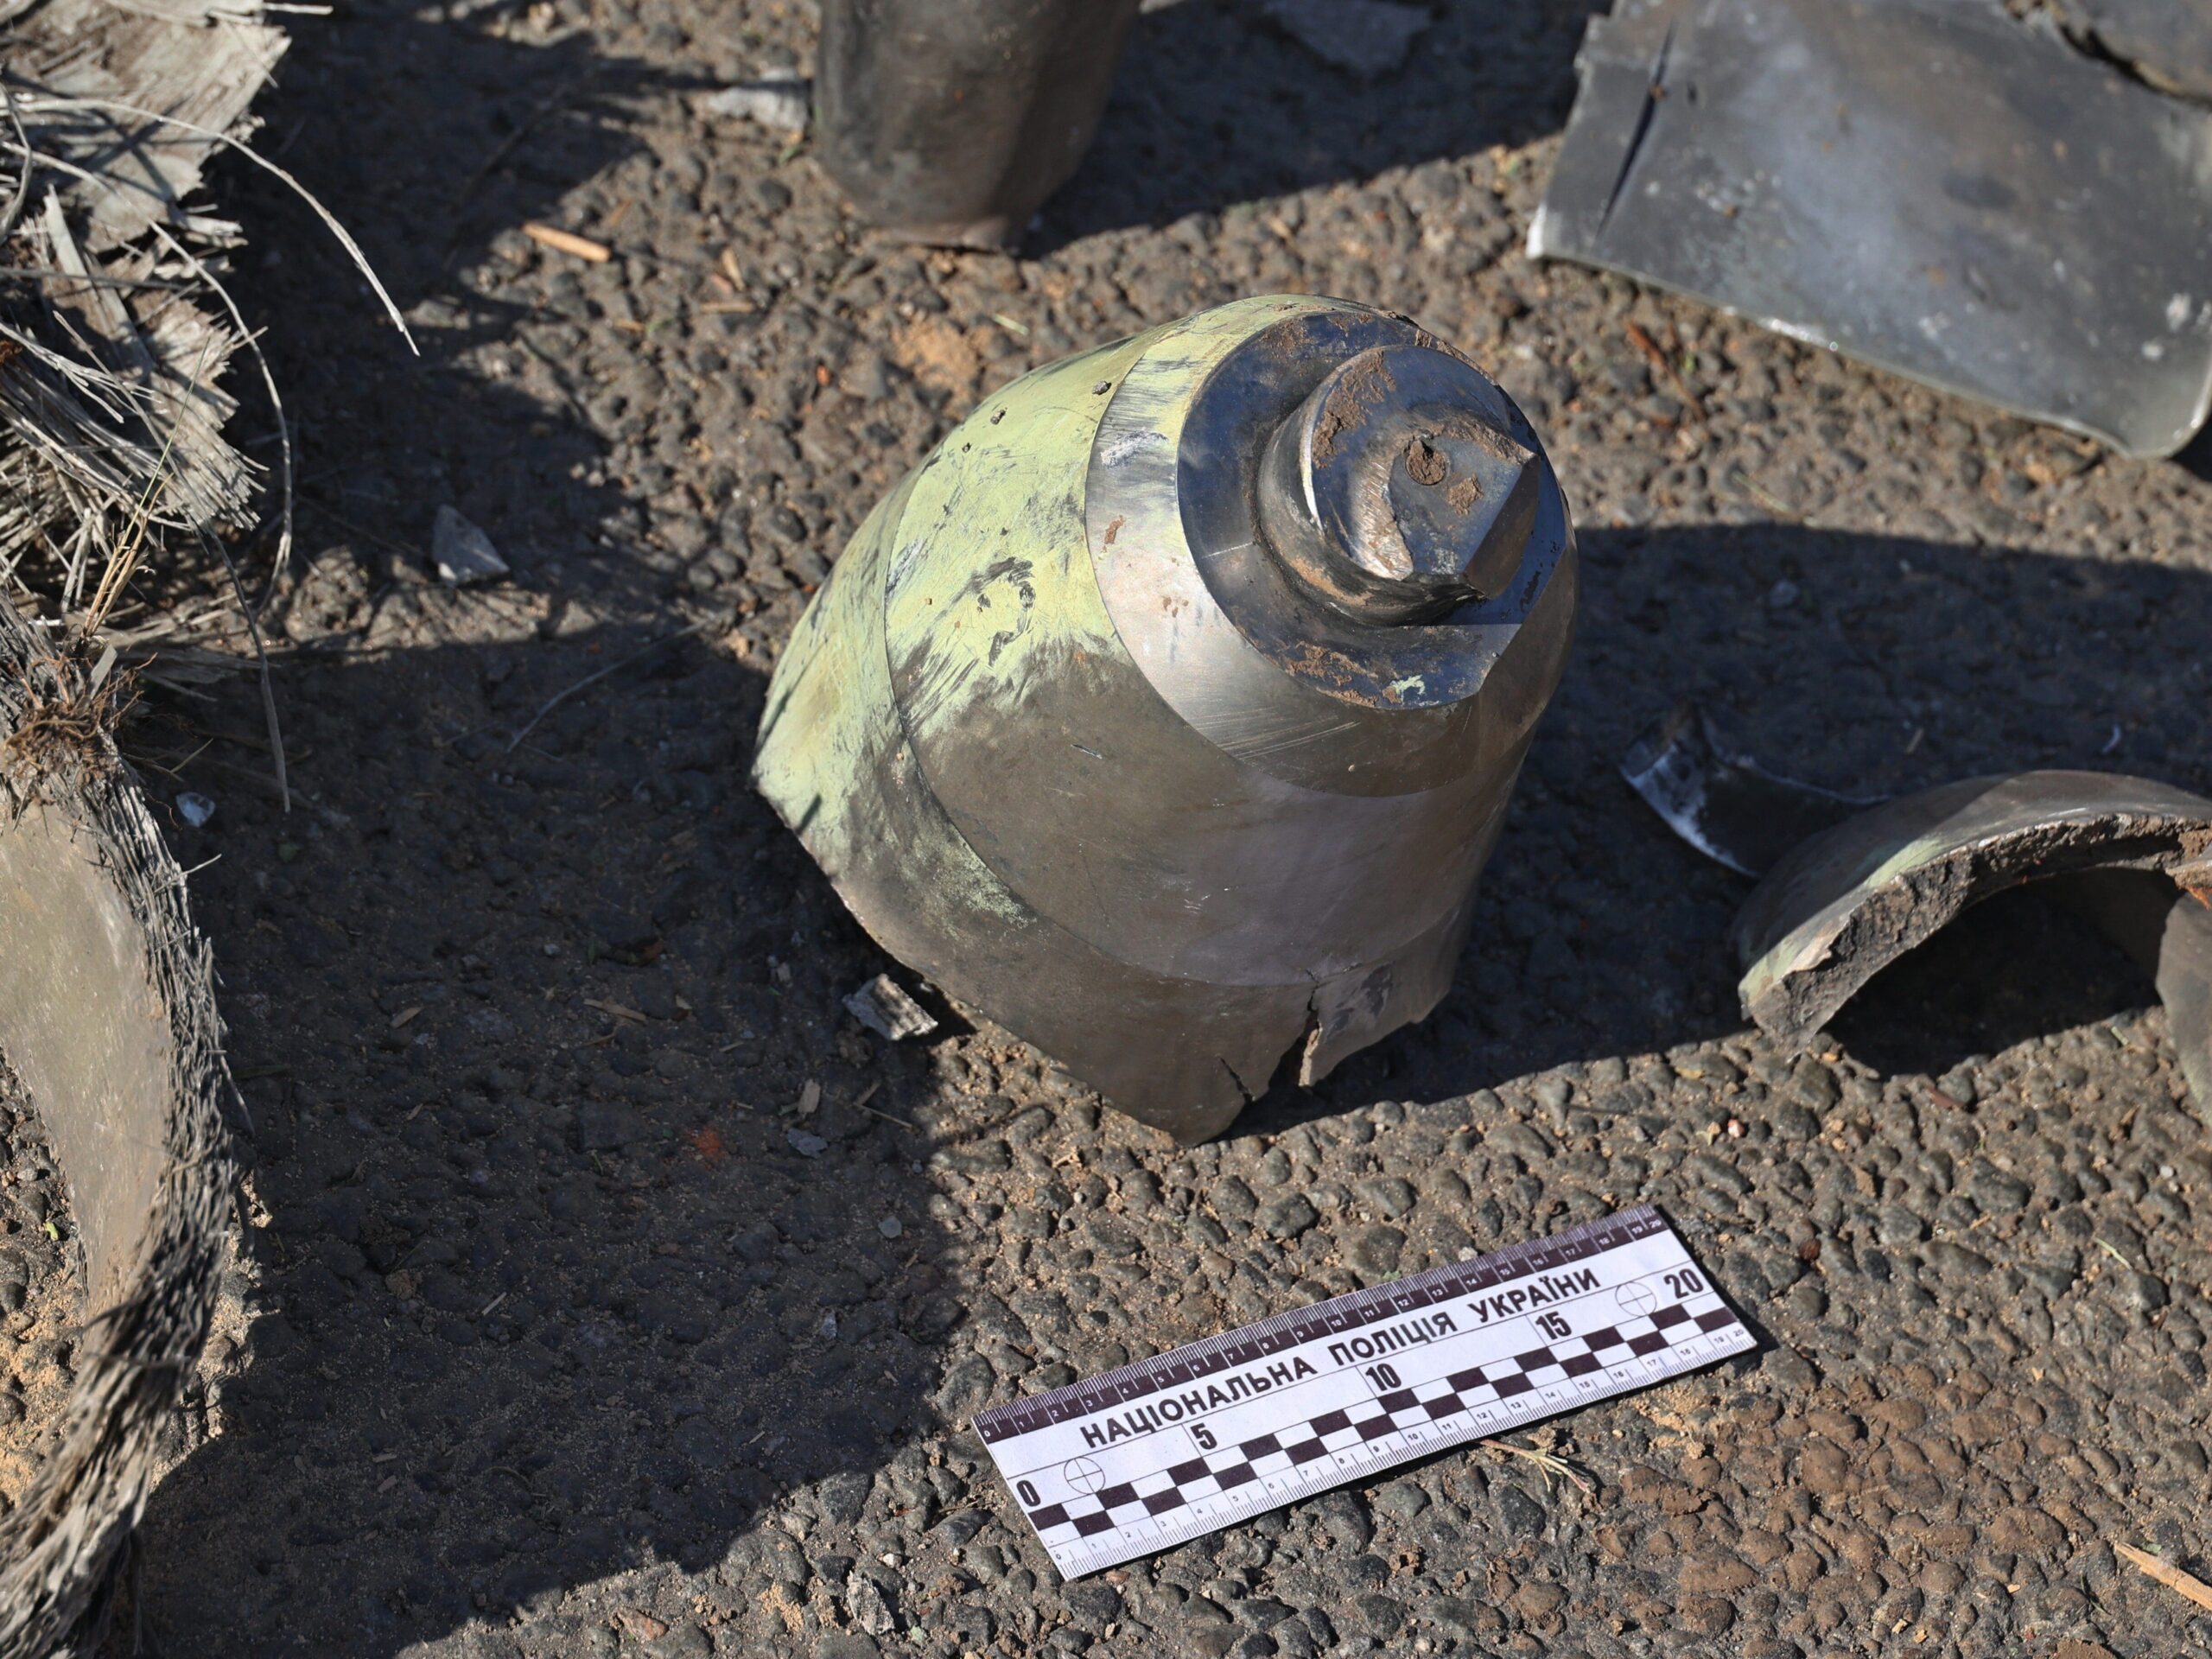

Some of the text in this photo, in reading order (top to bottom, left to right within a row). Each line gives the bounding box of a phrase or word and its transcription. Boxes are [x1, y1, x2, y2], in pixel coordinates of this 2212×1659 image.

[1016, 1268, 1704, 1507] 0 5 10 15 20
[1079, 1268, 1600, 1448] НАЦІОНАЛЬНА ПОЛІЦІЯ УКРАЇНИ
